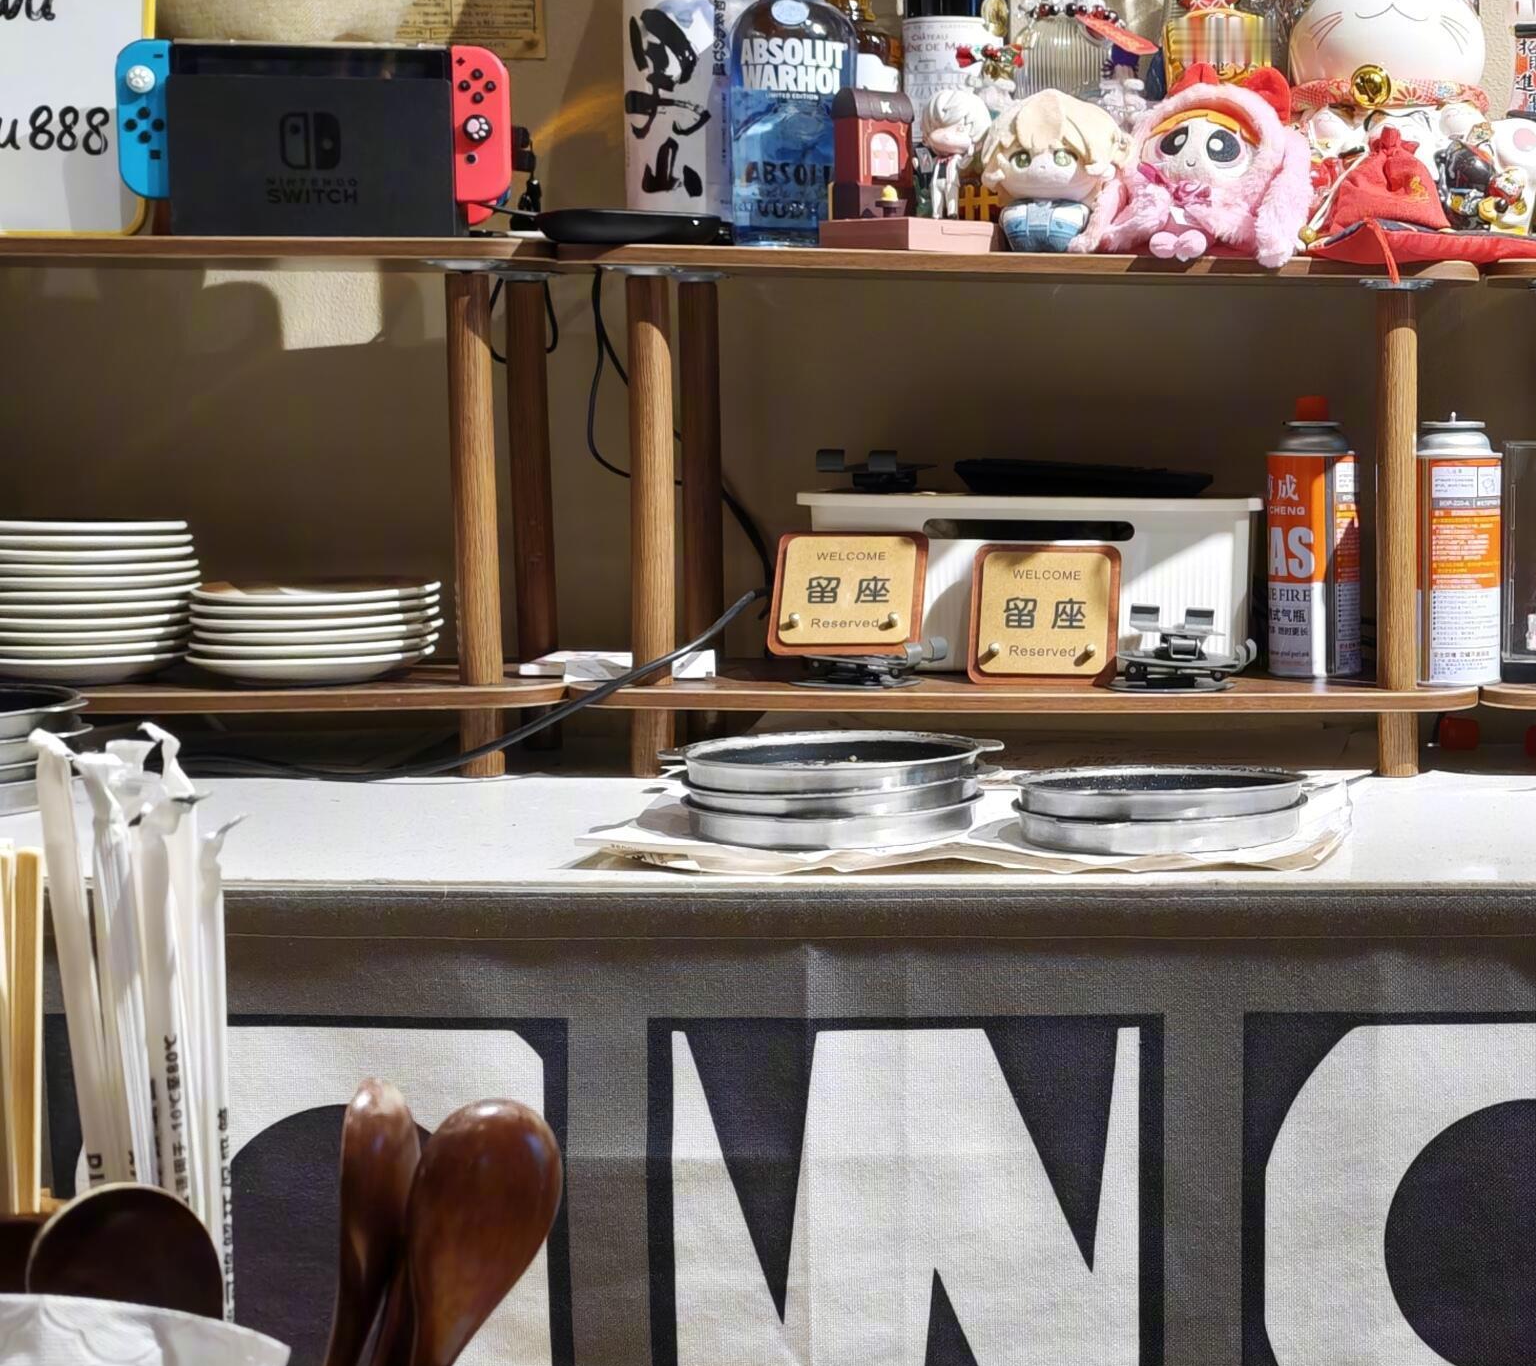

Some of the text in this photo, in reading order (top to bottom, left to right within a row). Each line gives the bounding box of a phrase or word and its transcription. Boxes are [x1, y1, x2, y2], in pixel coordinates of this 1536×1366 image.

[741, 37, 847, 69] ABSOLUT
[266, 188, 358, 204] SWITCH
[816, 551, 886, 561] WELCOME
[1269, 526, 1315, 578] AS
[1012, 569, 1082, 581] WELCOME
[806, 576, 891, 604] 留座
[1003, 597, 1087, 630] 留座
[811, 617, 879, 629] Reserved
[1008, 644, 1077, 658] Reserved
